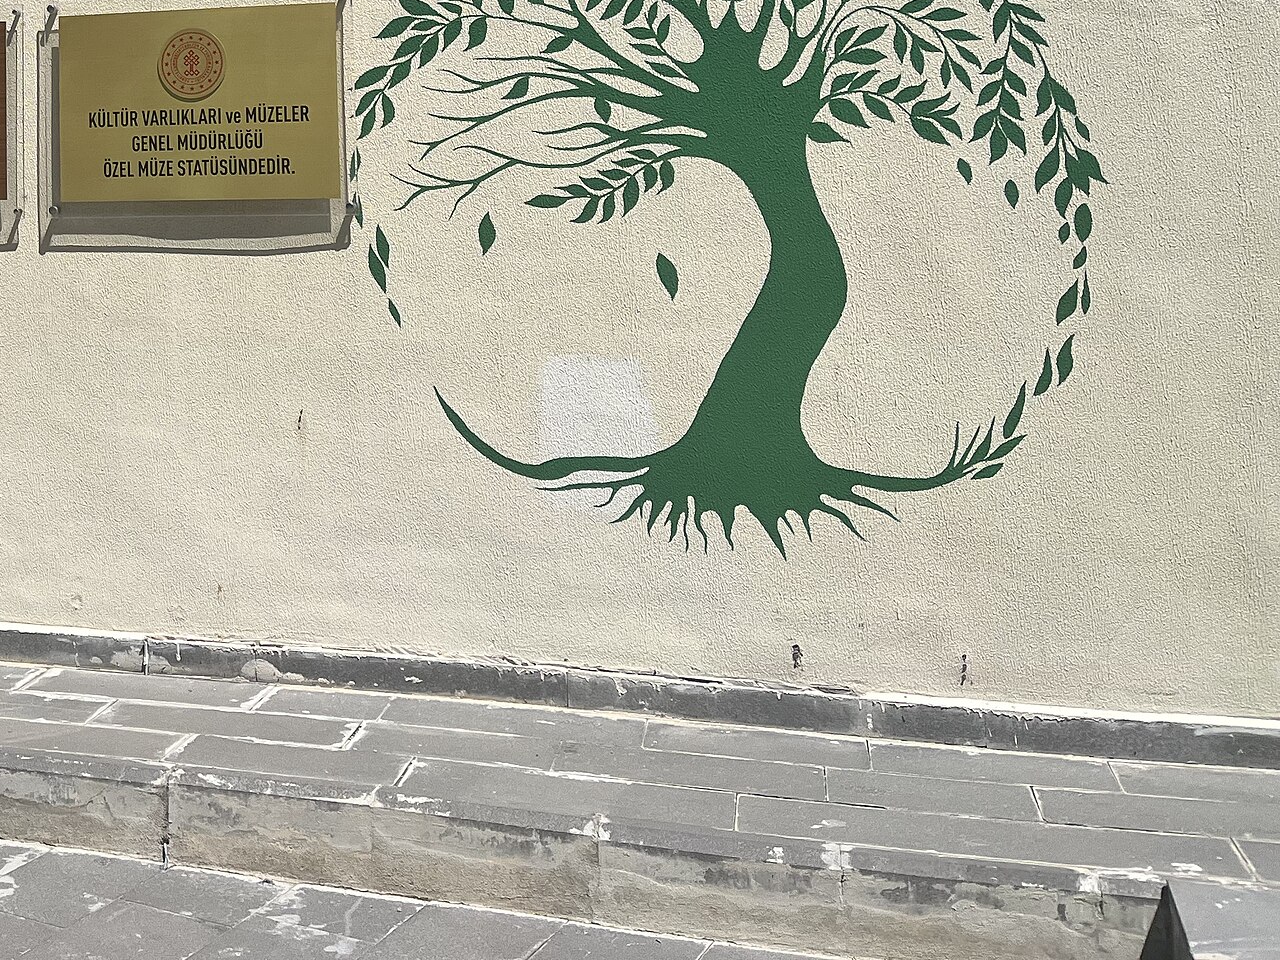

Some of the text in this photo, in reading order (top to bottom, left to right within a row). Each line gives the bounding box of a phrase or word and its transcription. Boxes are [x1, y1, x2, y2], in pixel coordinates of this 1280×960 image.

[88, 104, 310, 128] KÜLTÜR VARLIKLARI ve MÜZELER
[131, 129, 263, 152] GENEL MÜDÜRLÜĞÜ
[103, 154, 296, 178] ÖZEL MÜZE STATÜSÜNDEDİR.
